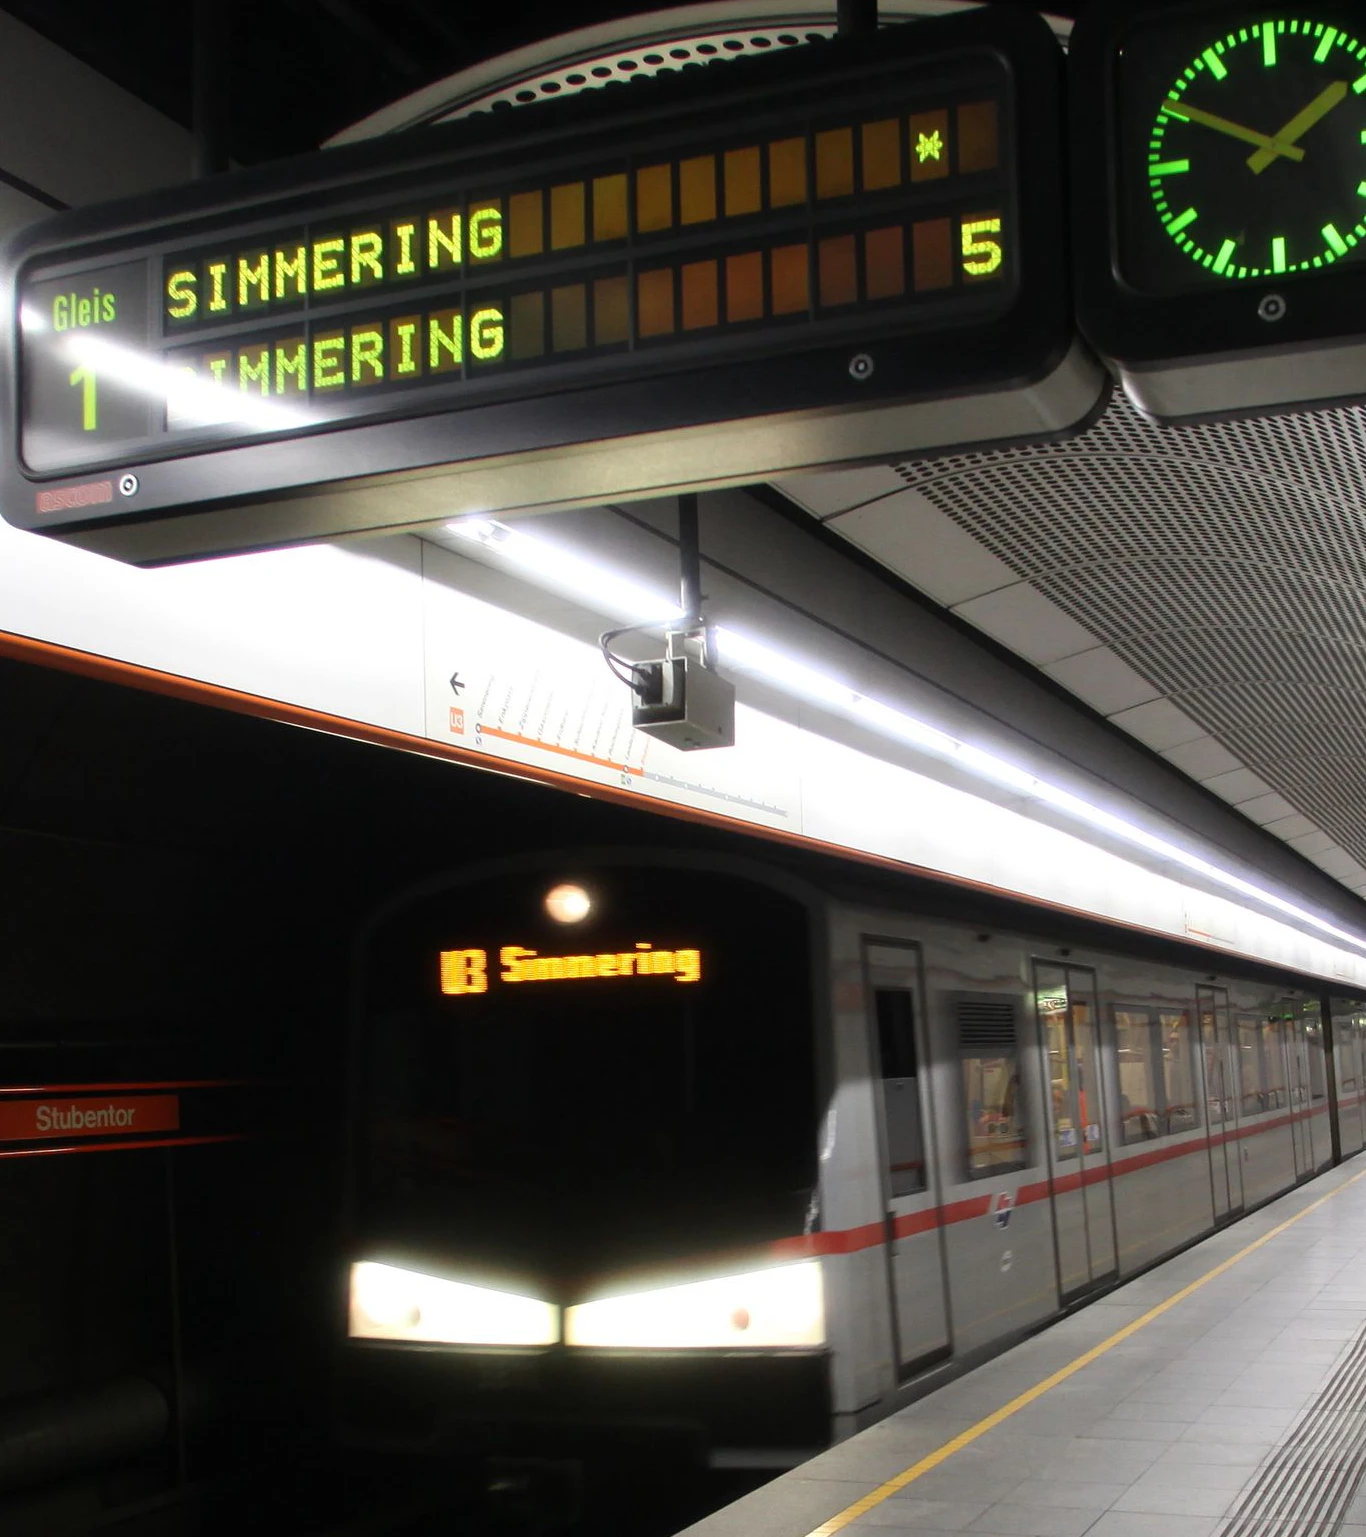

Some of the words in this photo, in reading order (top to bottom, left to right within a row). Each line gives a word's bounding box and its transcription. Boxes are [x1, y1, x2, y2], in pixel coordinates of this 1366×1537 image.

[167, 208, 504, 319] SIMMERING
[53, 289, 116, 333] Gleis
[174, 307, 505, 402] IMMERING
[961, 218, 1002, 276] 5
[69, 364, 97, 432] 1
[36, 1104, 136, 1132] Stubentor
